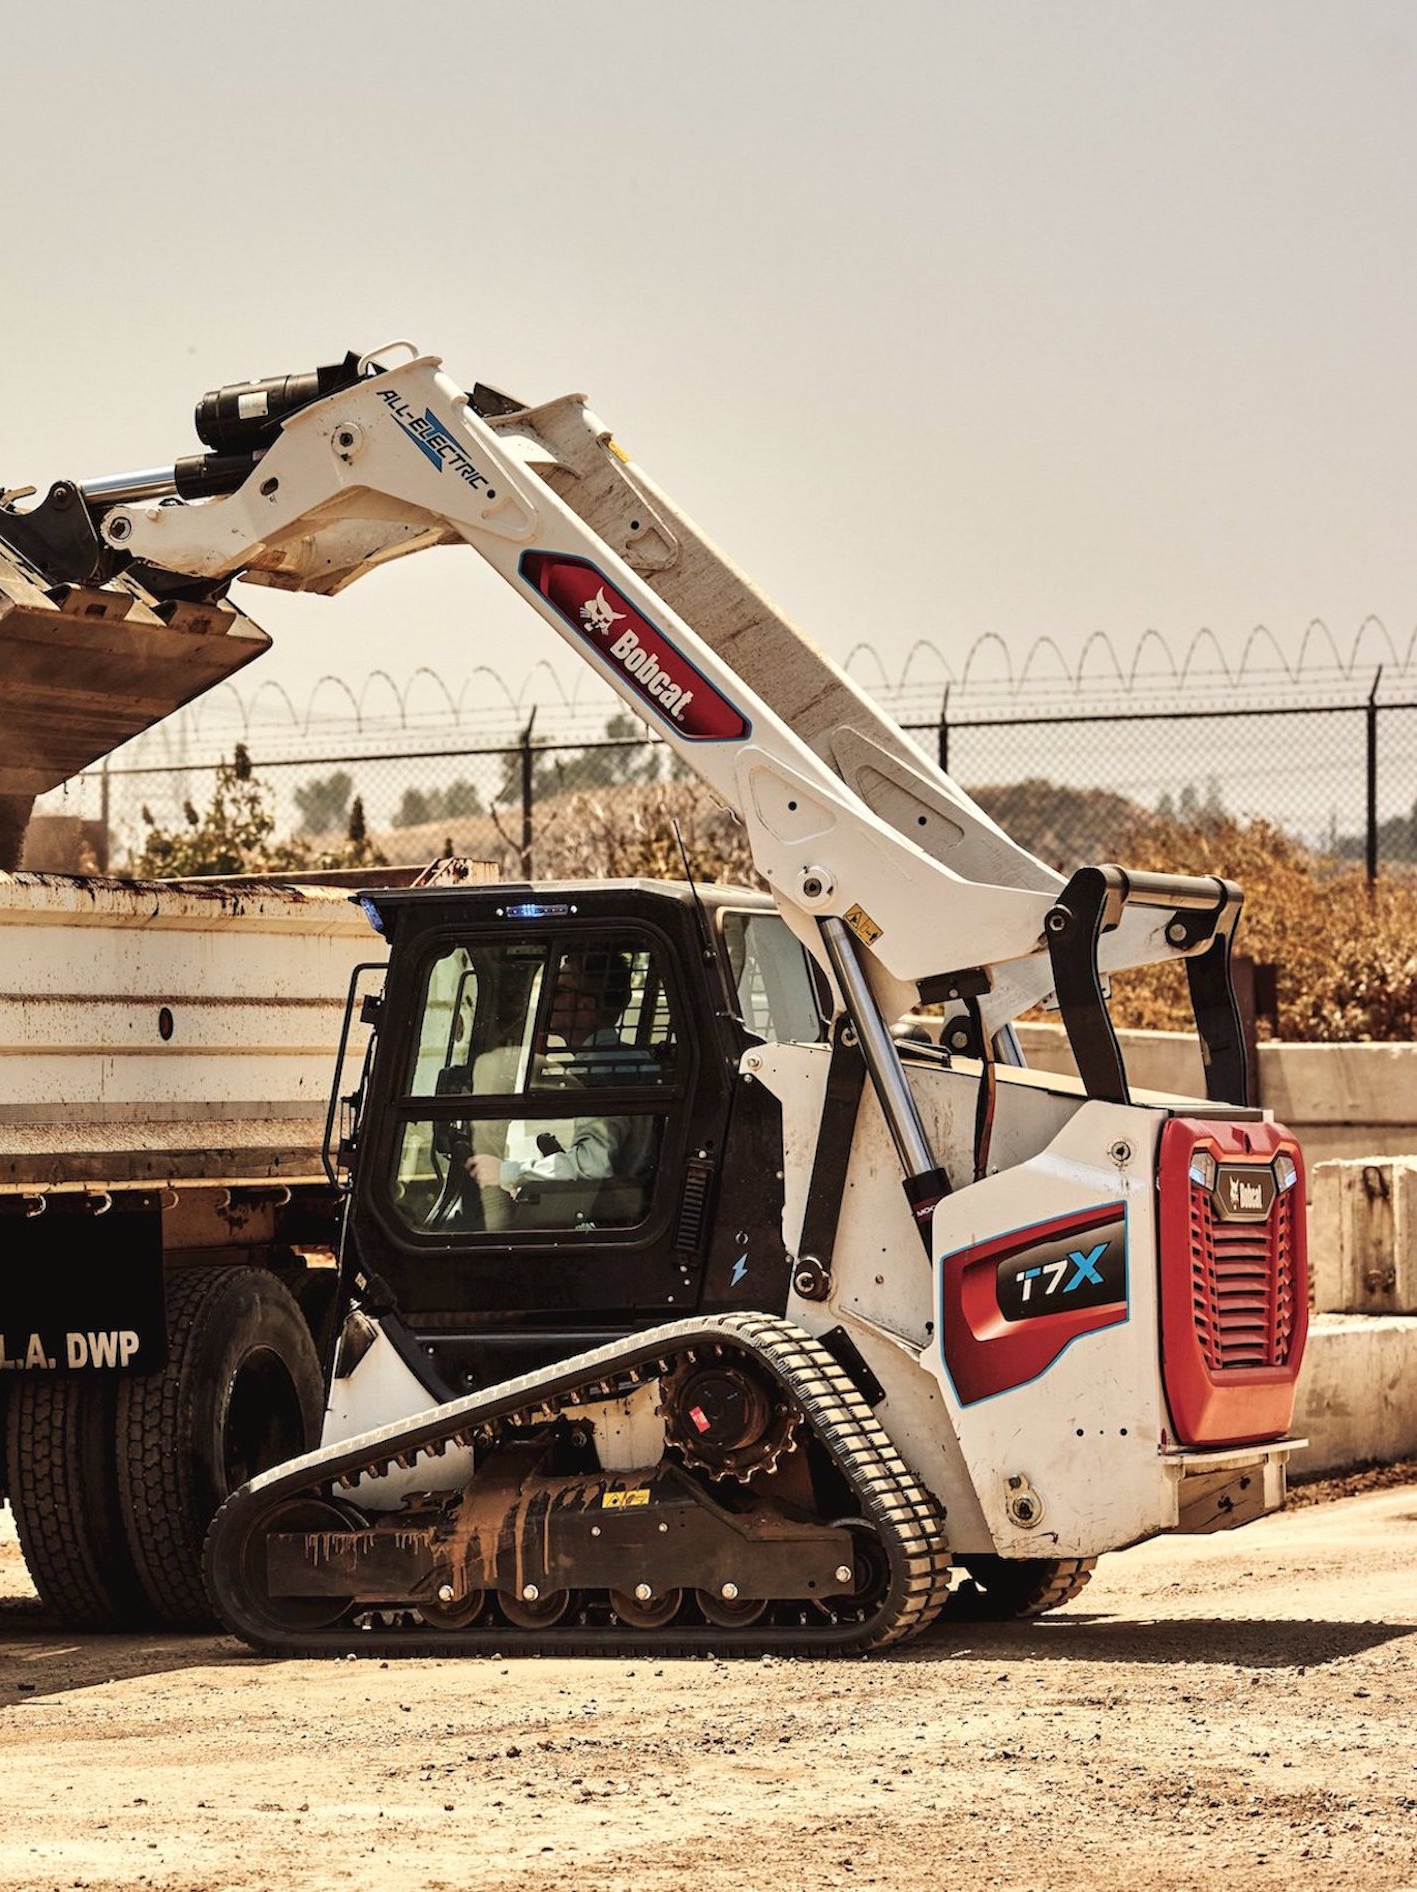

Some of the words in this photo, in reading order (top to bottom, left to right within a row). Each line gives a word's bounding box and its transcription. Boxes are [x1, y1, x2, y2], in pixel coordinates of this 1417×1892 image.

[375, 389, 490, 490] ALL-ELECTRIC
[609, 628, 695, 721] Bobcat
[1015, 1241, 1111, 1302] T7X
[65, 1330, 140, 1370] DWP
